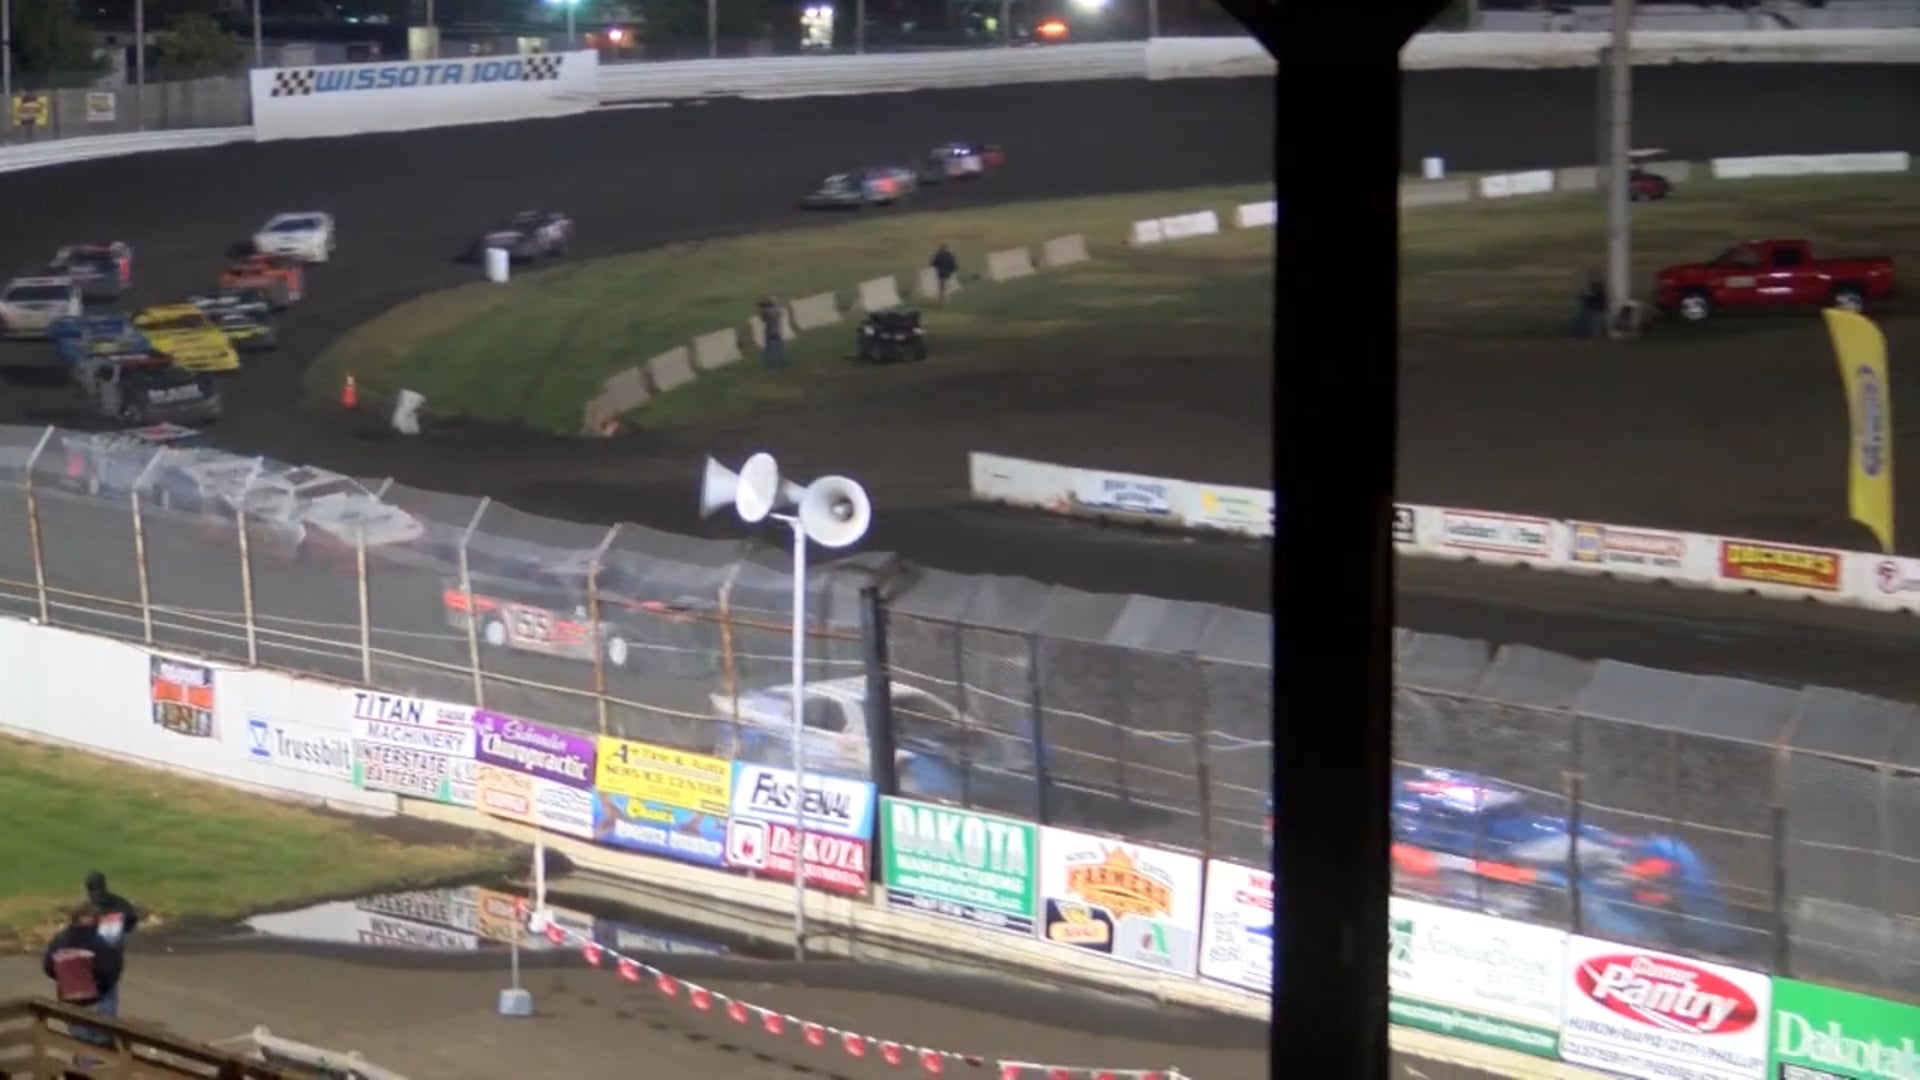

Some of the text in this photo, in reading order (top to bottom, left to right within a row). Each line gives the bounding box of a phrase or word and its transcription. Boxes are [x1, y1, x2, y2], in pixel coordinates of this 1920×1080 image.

[314, 60, 525, 93] WISSOTA 100
[354, 692, 425, 724] TITAN
[275, 728, 351, 770] Trussbilt
[367, 721, 466, 752] MACHINERY
[356, 739, 447, 776] INTERSTATE
[363, 765, 439, 794] BATTERIES
[751, 771, 852, 820] FASENAL
[891, 802, 1028, 878] DAKOTA
[1066, 866, 1169, 908] FARMERS
[1592, 962, 1741, 1032] Pantry
